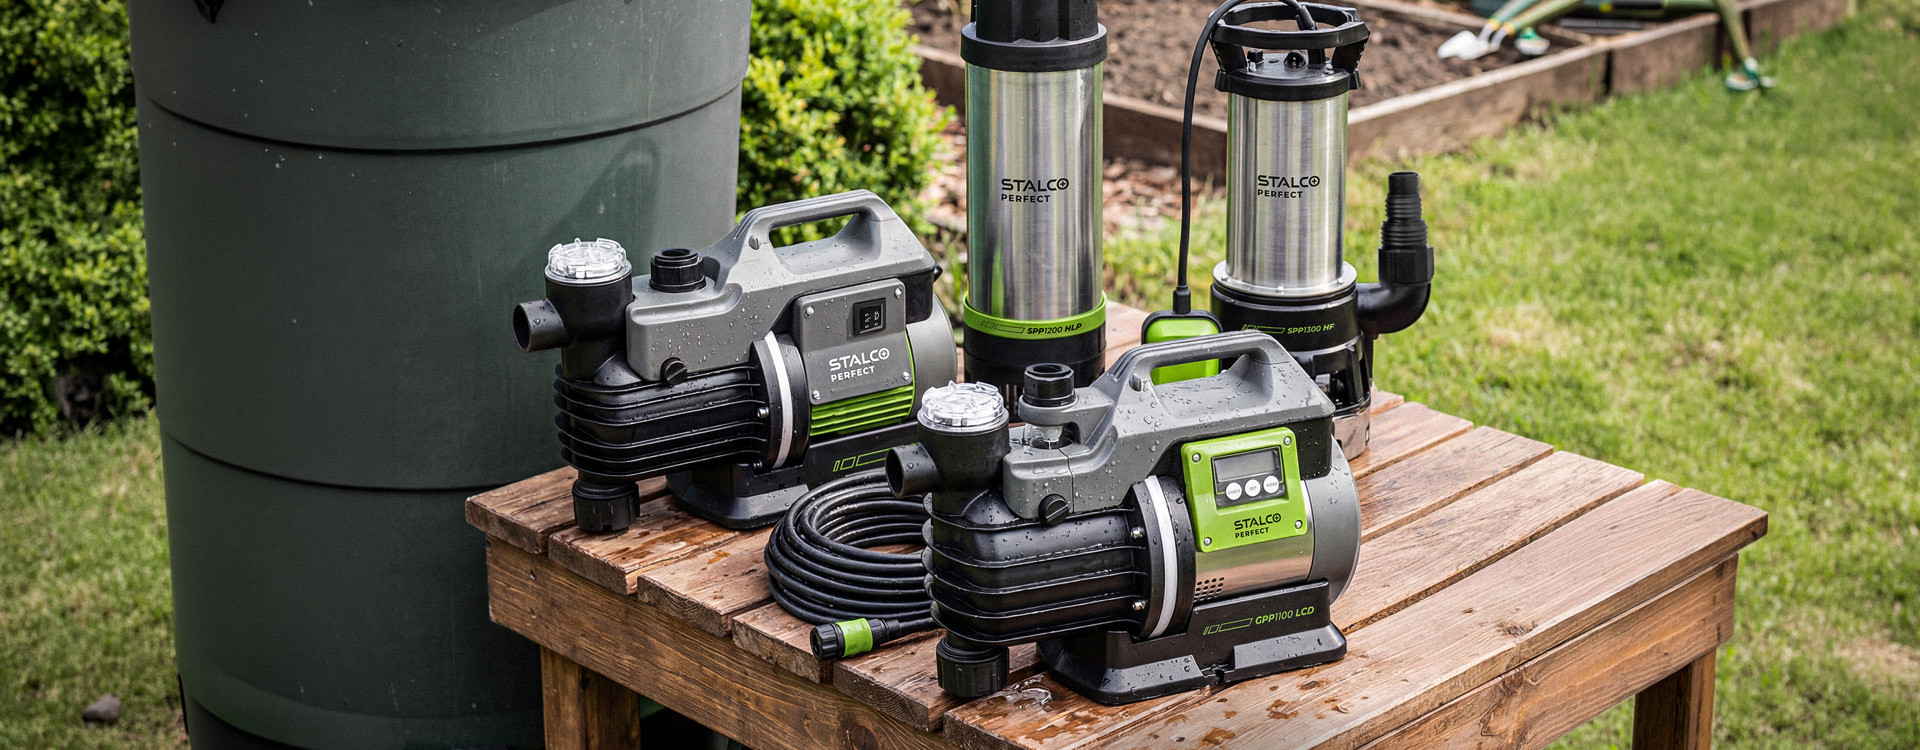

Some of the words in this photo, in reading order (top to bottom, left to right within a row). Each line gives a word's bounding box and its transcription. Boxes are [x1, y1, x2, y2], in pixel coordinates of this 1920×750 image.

[1001, 177, 1069, 192] STALCO
[1257, 174, 1320, 188] STALCO
[1001, 193, 1051, 202] PERFECT
[1257, 189, 1303, 198] PERFECT
[1027, 326, 1063, 335] SPP1200
[1064, 322, 1082, 332] HLP
[1287, 325, 1322, 334] SPP1300
[1322, 323, 1335, 331] HF
[828, 347, 890, 372] STALCO
[830, 365, 875, 382] PERFECT
[1234, 513, 1282, 530] STALCO
[1235, 527, 1269, 538] PERFECT
[1255, 610, 1294, 625] GPP1100
[1295, 606, 1315, 617] LCD
